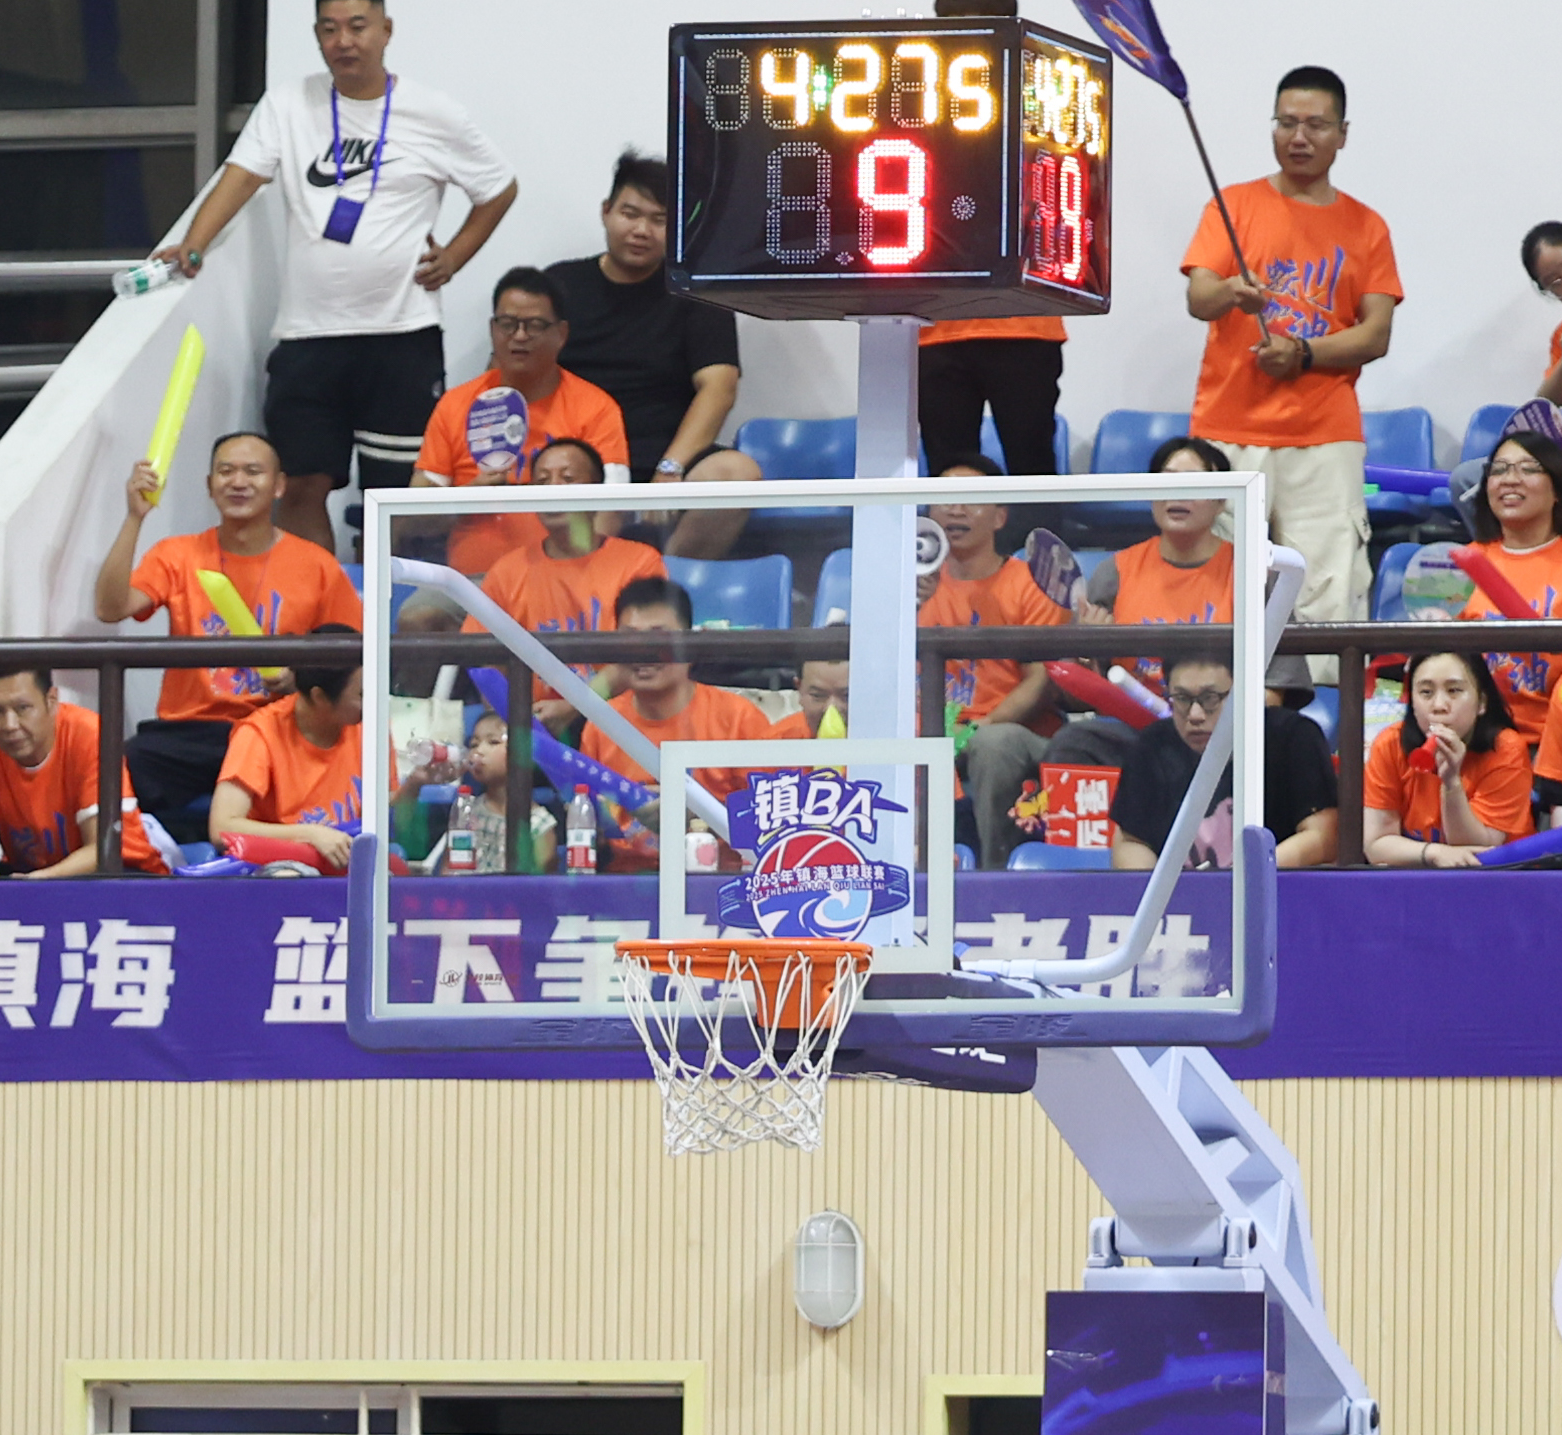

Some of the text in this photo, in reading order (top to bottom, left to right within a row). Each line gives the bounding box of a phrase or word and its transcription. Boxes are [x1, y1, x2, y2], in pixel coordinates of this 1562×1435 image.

[857, 137, 929, 267] 9
[1266, 245, 1346, 314] 蛟川
[753, 773, 875, 835] 镇BA
[744, 863, 886, 892] 2025年镇海篮球联赛
[765, 885, 790, 899] ZHEN
[790, 883, 811, 894] HAI
[832, 880, 850, 892] QIU
[852, 880, 873, 891] LIAN
[873, 881, 886, 891] SAI
